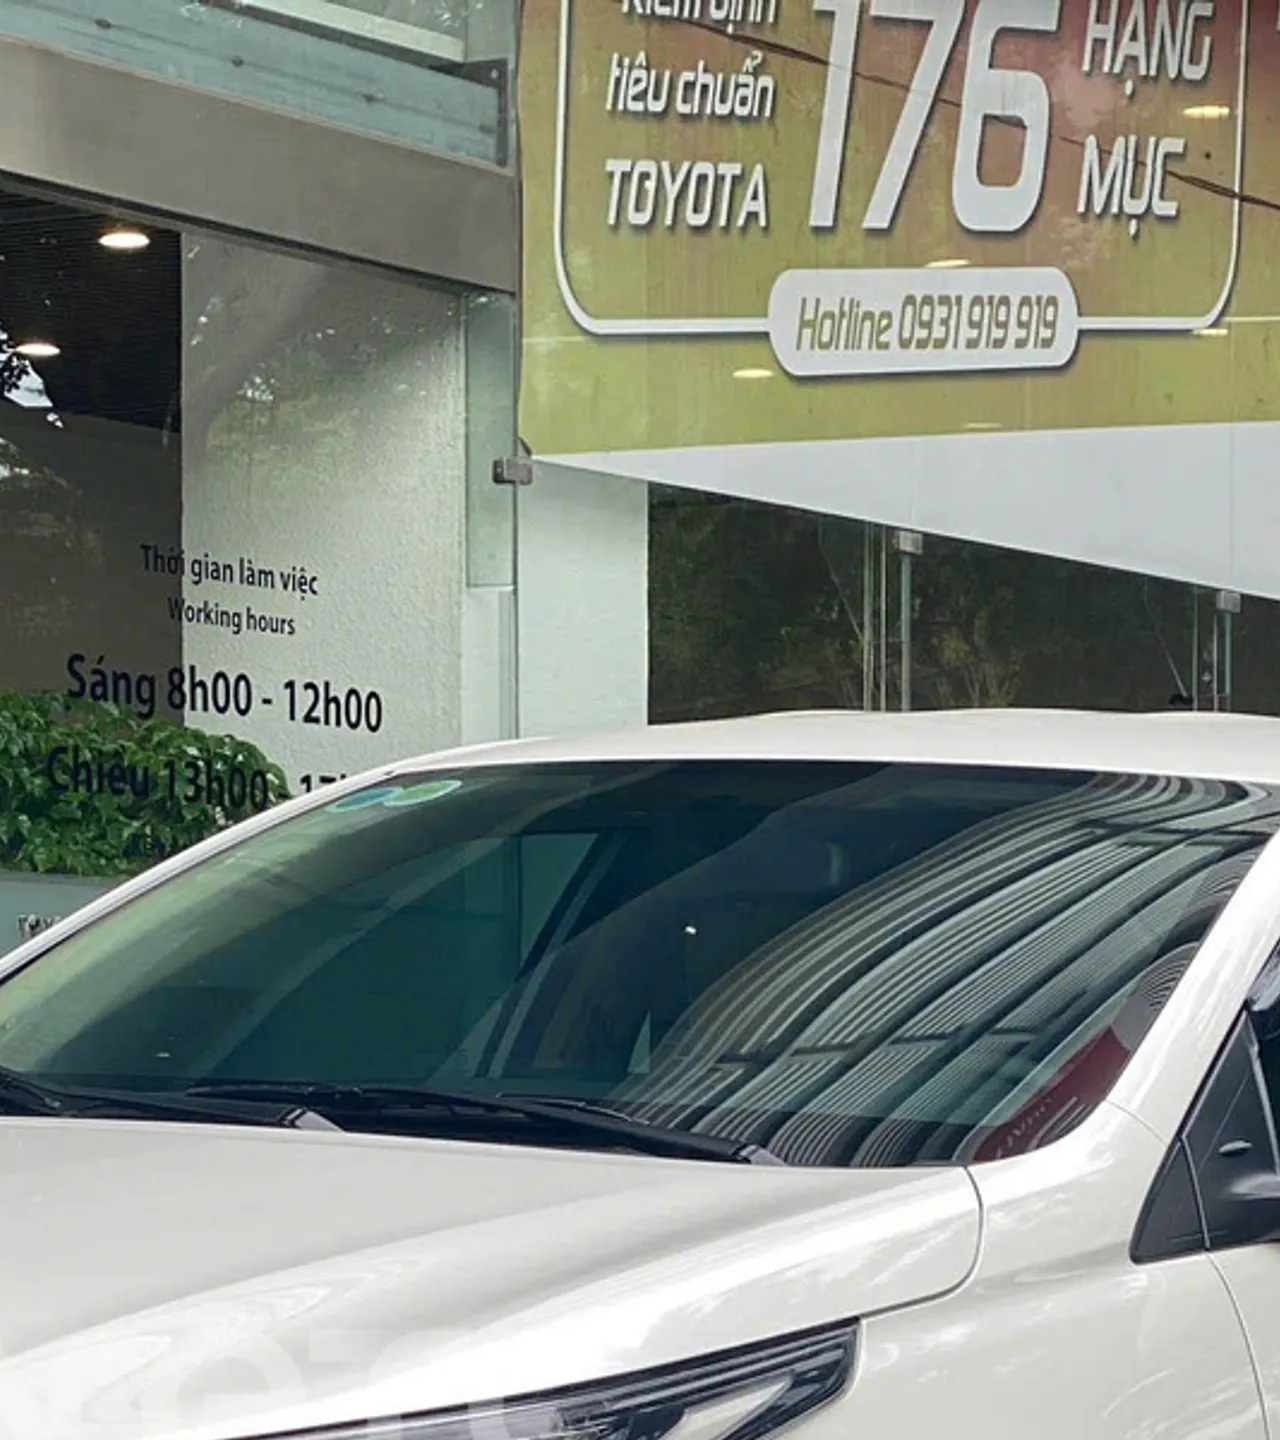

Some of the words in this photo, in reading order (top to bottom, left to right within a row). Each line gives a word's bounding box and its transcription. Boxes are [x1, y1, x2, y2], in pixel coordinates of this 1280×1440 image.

[1081, 0, 1215, 97] HẠNG
[605, 50, 671, 113] tiêu
[675, 50, 775, 117] chuẩn
[807, 0, 1061, 233] 176
[605, 160, 768, 228] TOYOTA
[1077, 135, 1188, 239] MỤC
[796, 296, 893, 351] Hotline
[898, 294, 963, 350] 0931
[965, 294, 1012, 350] 919
[1014, 294, 1060, 350] 919
[191, 553, 234, 586] gian
[239, 557, 275, 589] làm
[279, 566, 319, 601] việc
[167, 597, 242, 635] Working
[246, 607, 296, 635] hours
[67, 653, 156, 720] Sáng
[166, 664, 253, 717] 8h00
[284, 679, 383, 733] 12h00
